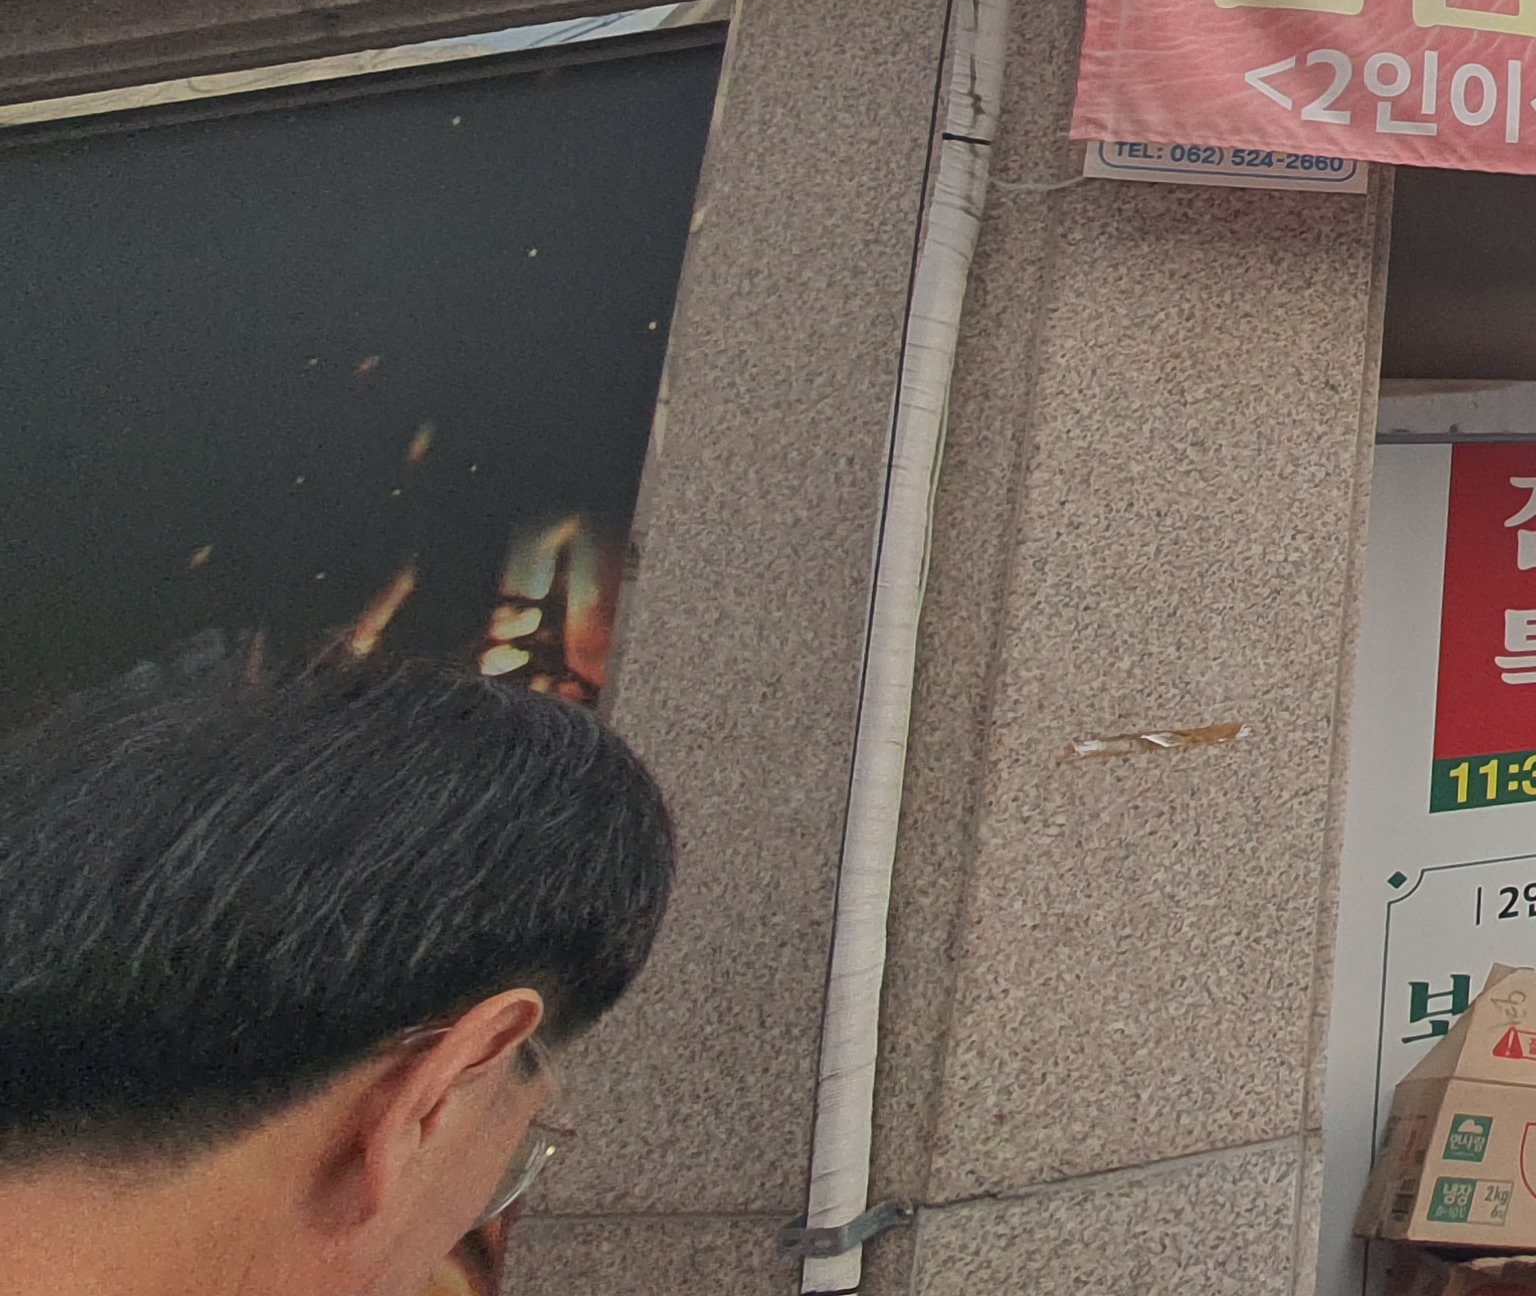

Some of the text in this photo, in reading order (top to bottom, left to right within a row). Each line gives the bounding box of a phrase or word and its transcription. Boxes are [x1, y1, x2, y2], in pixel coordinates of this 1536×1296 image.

[1115, 141, 1345, 172] TEL: 062) 524-2660
[1443, 1182, 1473, 1205] 냉장
[1484, 1184, 1509, 1205] 2kg
